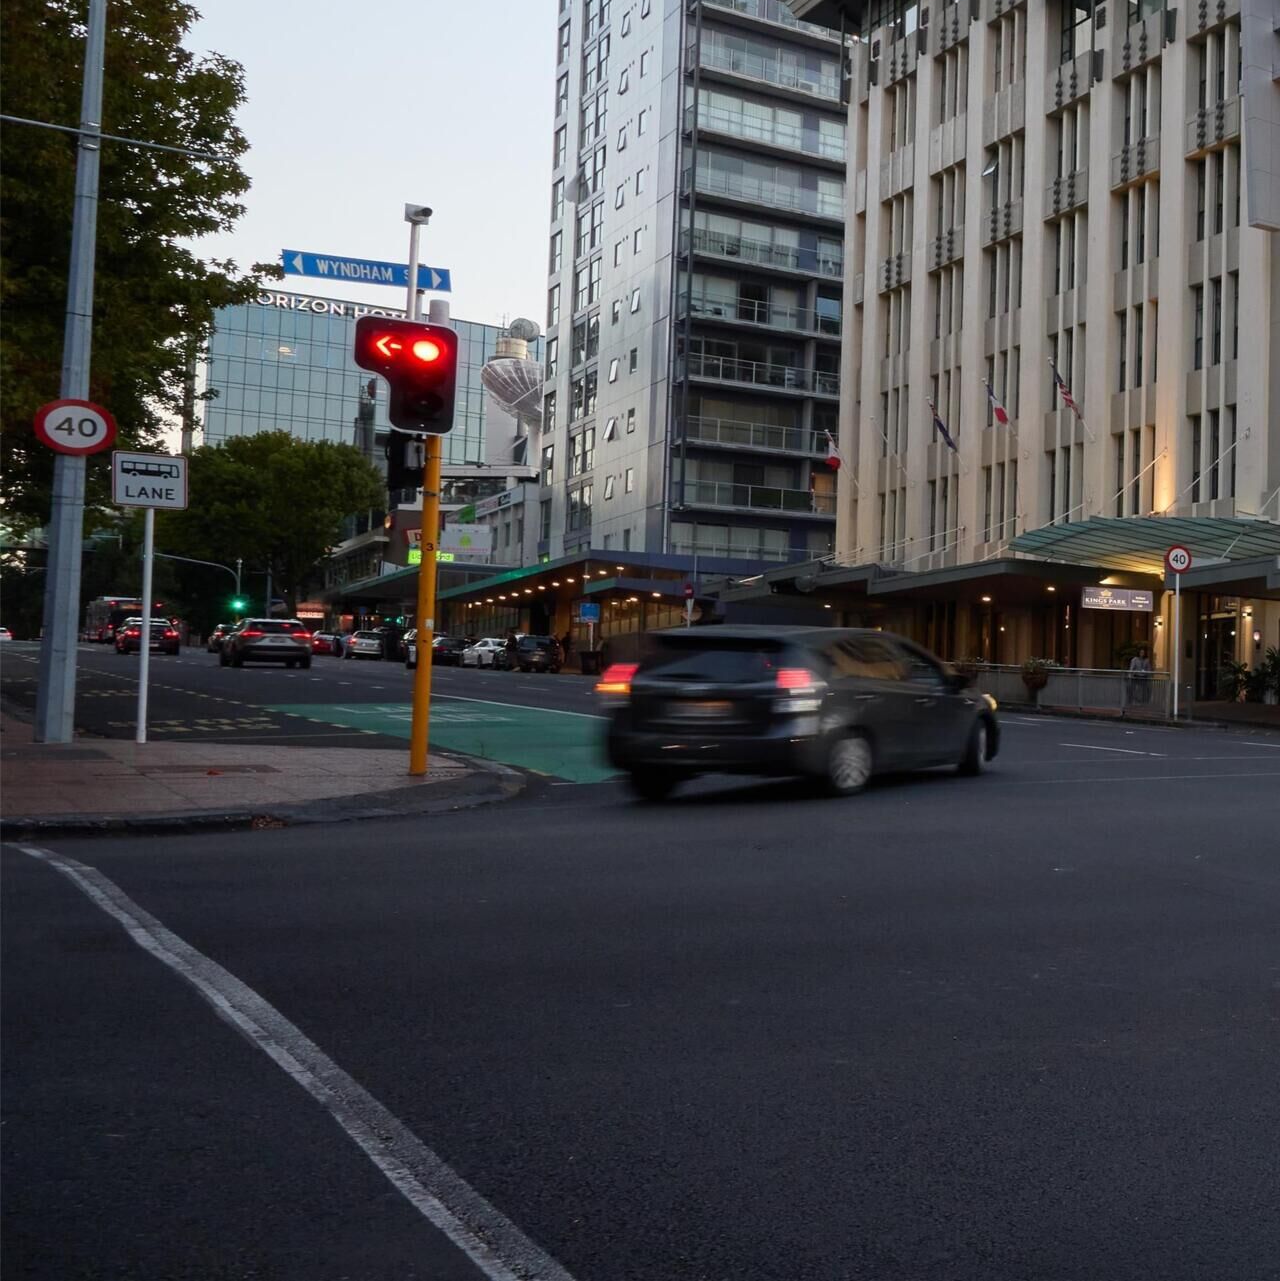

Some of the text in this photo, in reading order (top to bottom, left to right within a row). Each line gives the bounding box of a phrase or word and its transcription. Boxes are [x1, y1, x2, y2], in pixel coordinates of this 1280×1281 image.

[316, 259, 394, 282] WYNDHAM
[244, 292, 345, 315] ORIZON
[53, 417, 98, 438] 40
[125, 485, 176, 500] LANE
[426, 543, 434, 551] 3
[1172, 554, 1186, 565] 40
